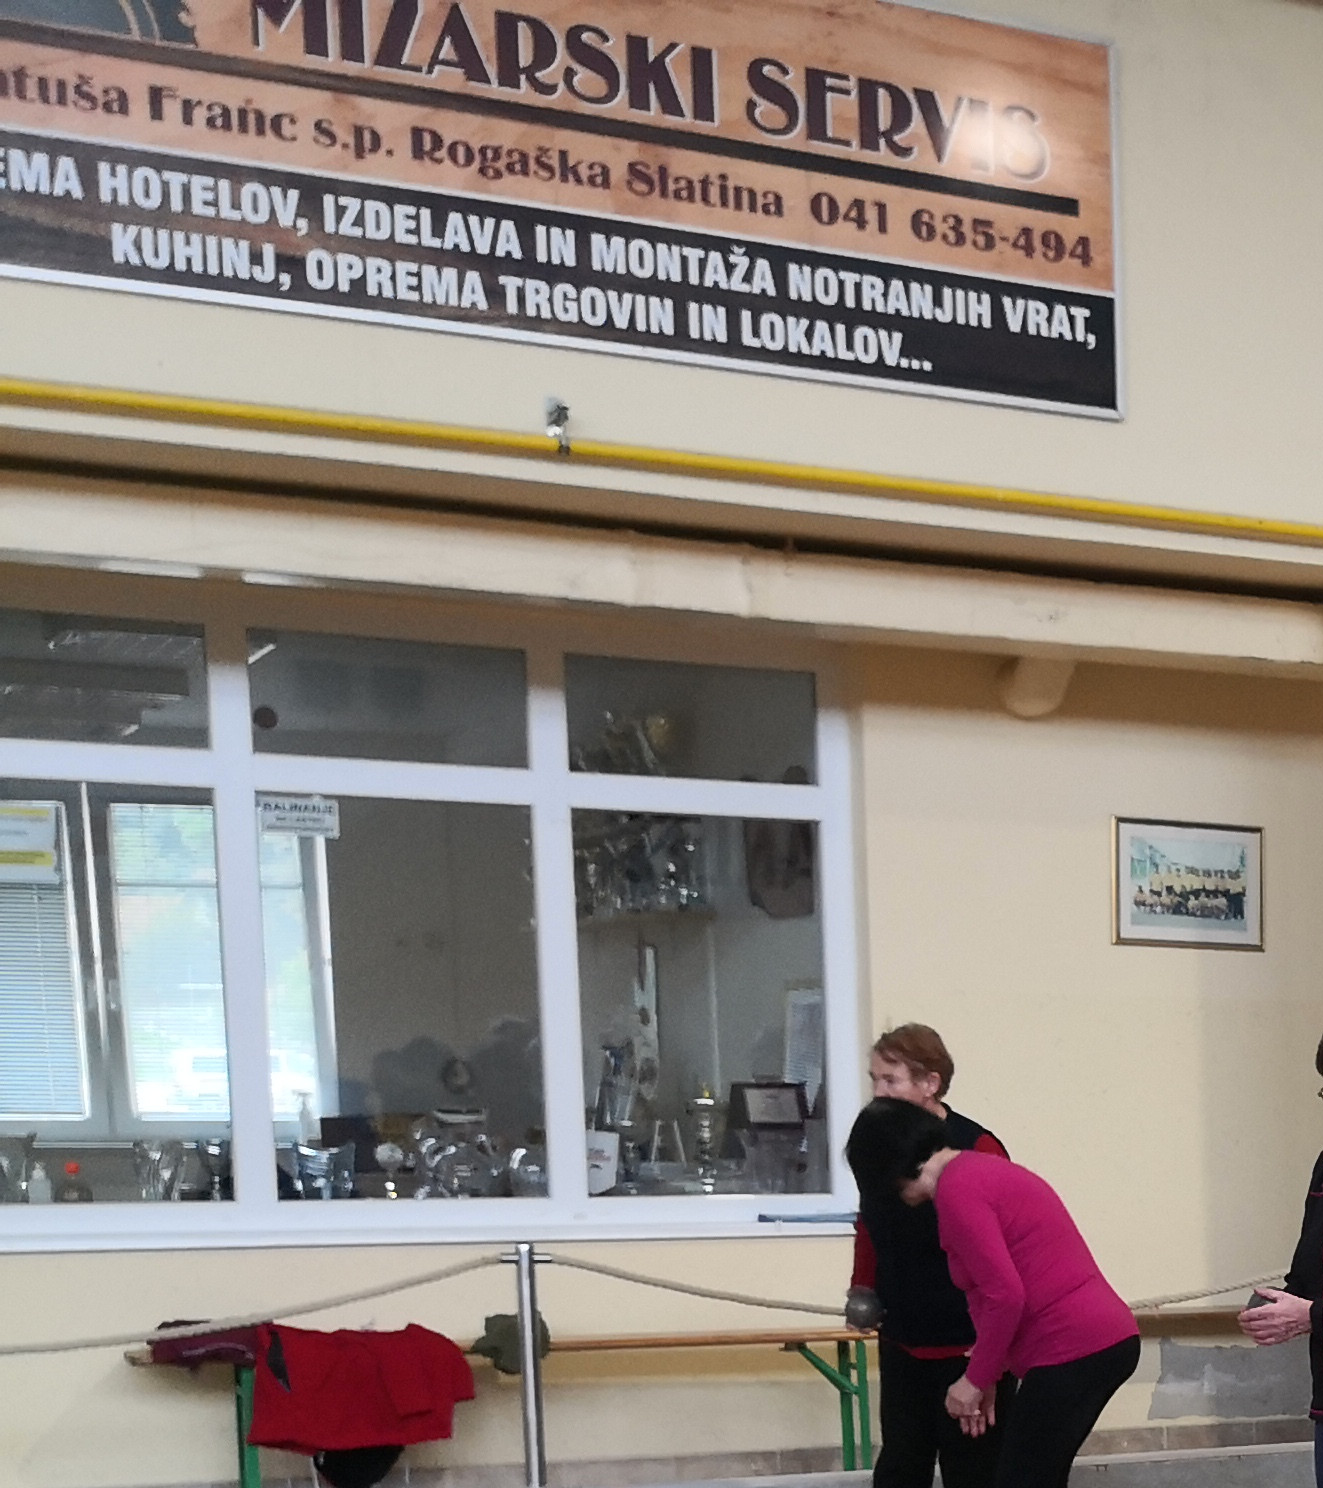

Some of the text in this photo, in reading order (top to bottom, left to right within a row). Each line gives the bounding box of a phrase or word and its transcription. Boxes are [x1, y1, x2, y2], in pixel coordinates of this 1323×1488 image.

[149, 82, 298, 142] Franc
[313, 115, 394, 160] s.p.
[411, 126, 611, 190] Rogaška
[626, 159, 784, 218] Slatina
[810, 191, 889, 235] 041
[910, 208, 1094, 268] 635-494
[746, 57, 1051, 182] SERVIS
[97, 160, 309, 236] HOTELOV,
[322, 193, 523, 260] IZDELAVA
[535, 224, 576, 267] IN
[591, 233, 776, 297] MONTAŽA
[787, 262, 992, 330] NOTRANJIH
[1002, 295, 1098, 351] VRAT,
[111, 221, 934, 372] KUHINJ, OPREMA TRGOVIN IN LOKALOV...
